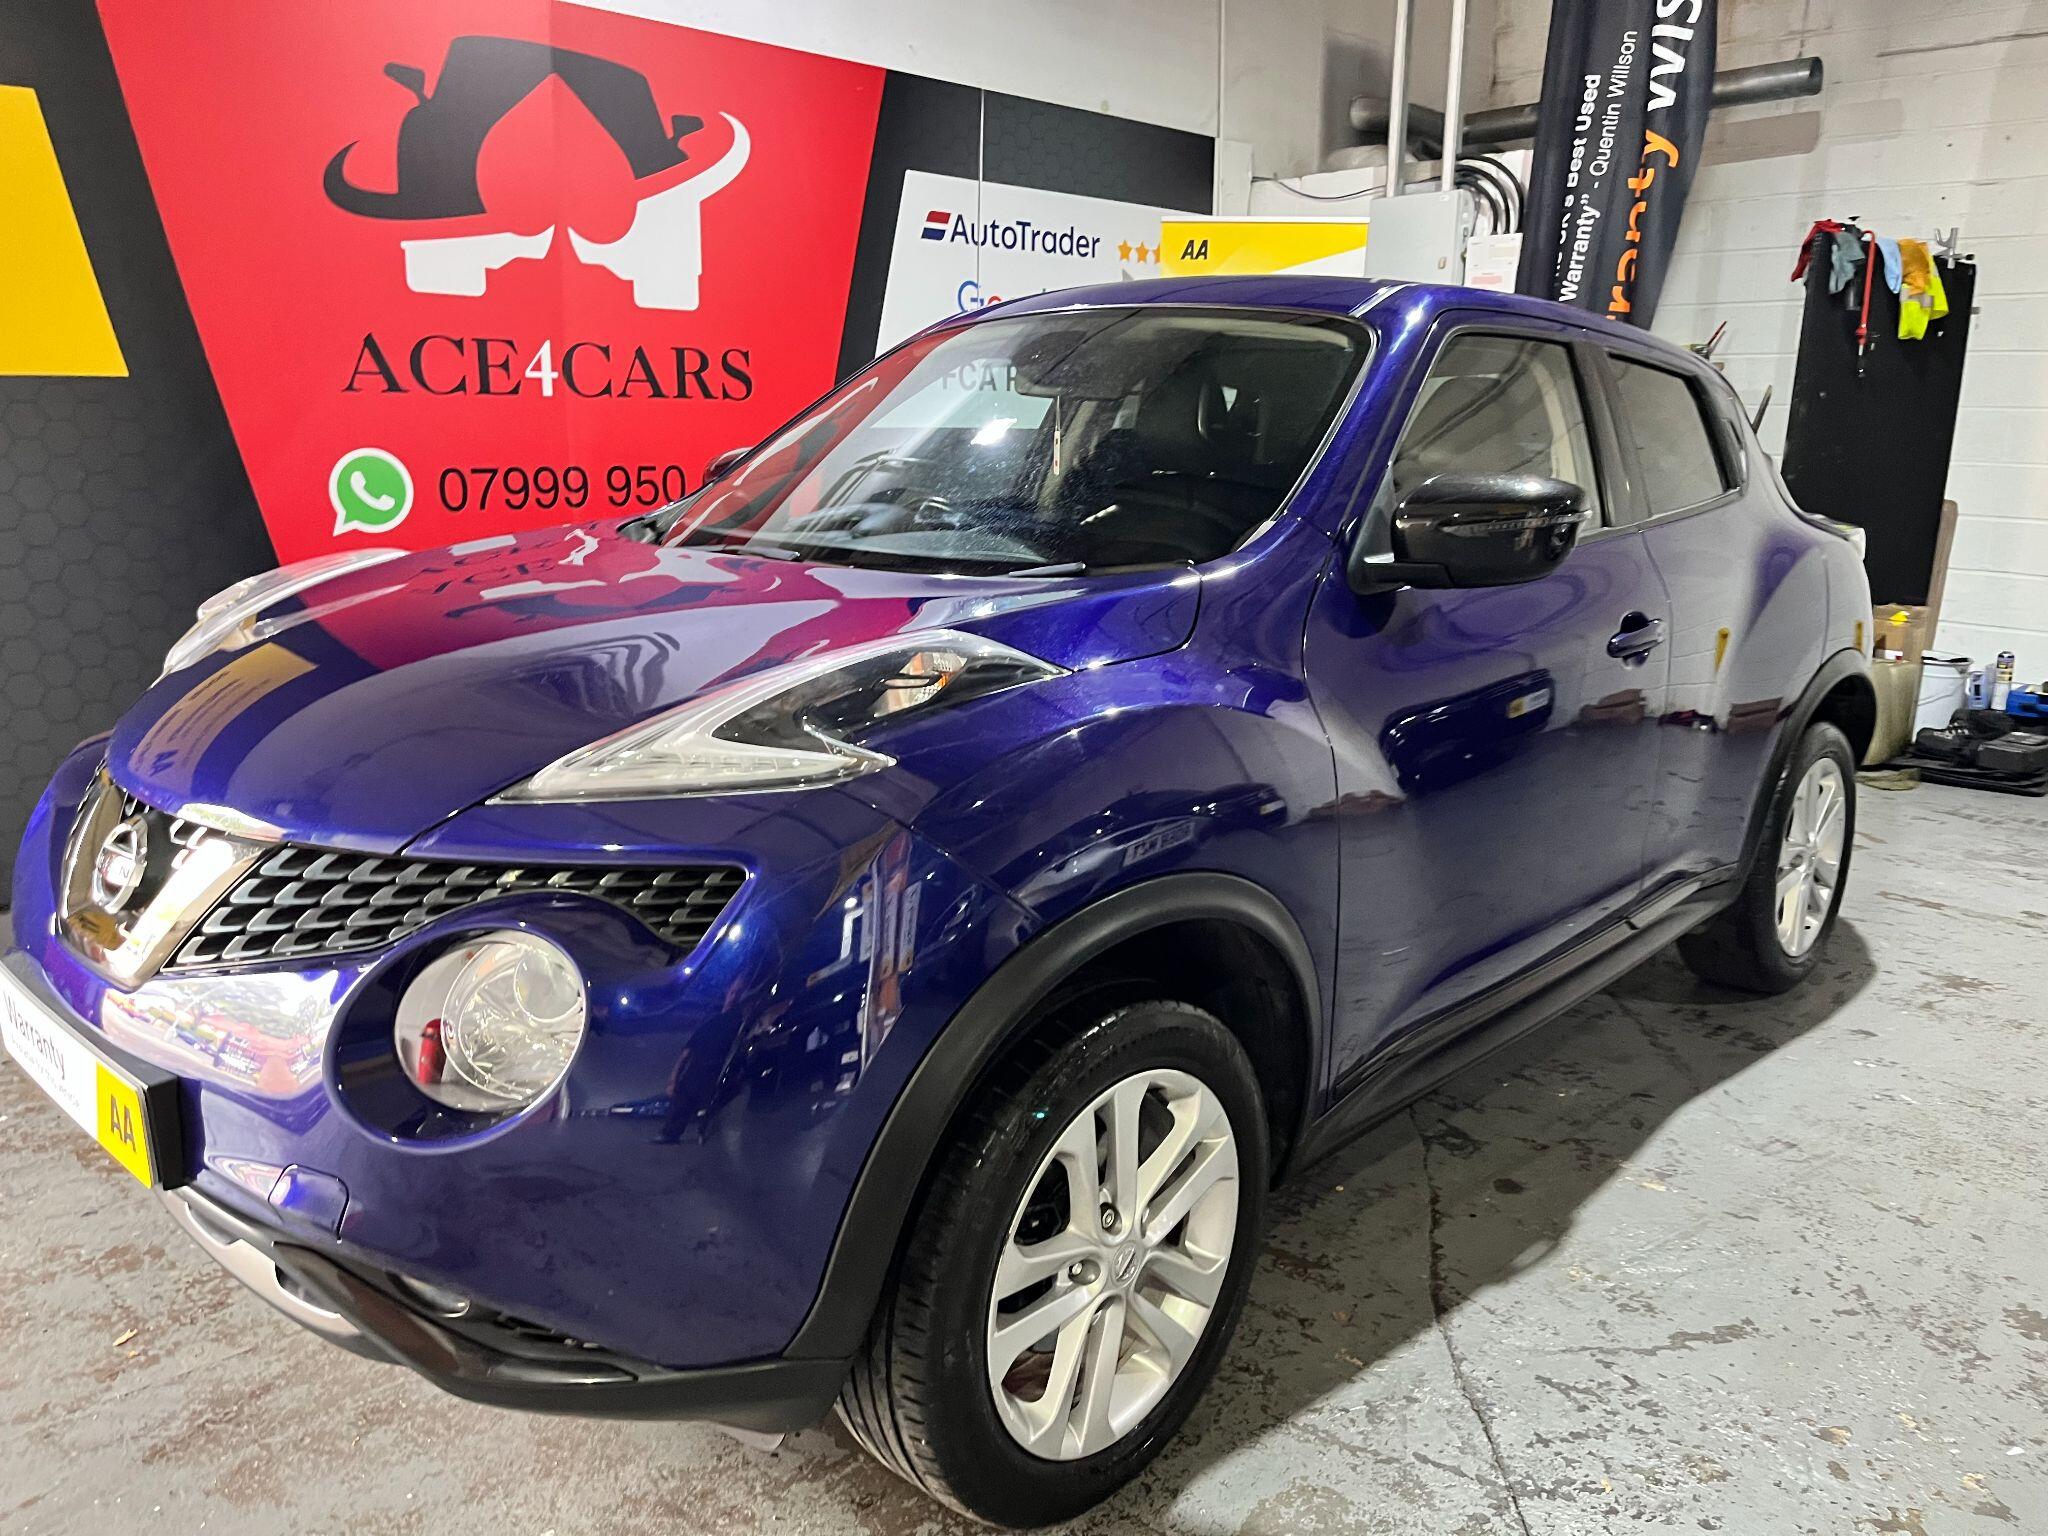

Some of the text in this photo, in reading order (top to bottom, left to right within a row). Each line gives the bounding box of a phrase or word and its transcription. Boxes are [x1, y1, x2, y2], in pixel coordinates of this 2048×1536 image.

[1575, 74, 1602, 132] Used
[1589, 103, 1621, 177] Quentin
[1607, 30, 1638, 98] Willson
[950, 213, 1101, 259] AutoTrader
[1180, 239, 1209, 261] AA
[341, 331, 754, 401] ACE4CARS
[439, 464, 686, 511] 07999 950
[3, 991, 65, 1080] Warranty
[110, 1094, 138, 1153] AA
